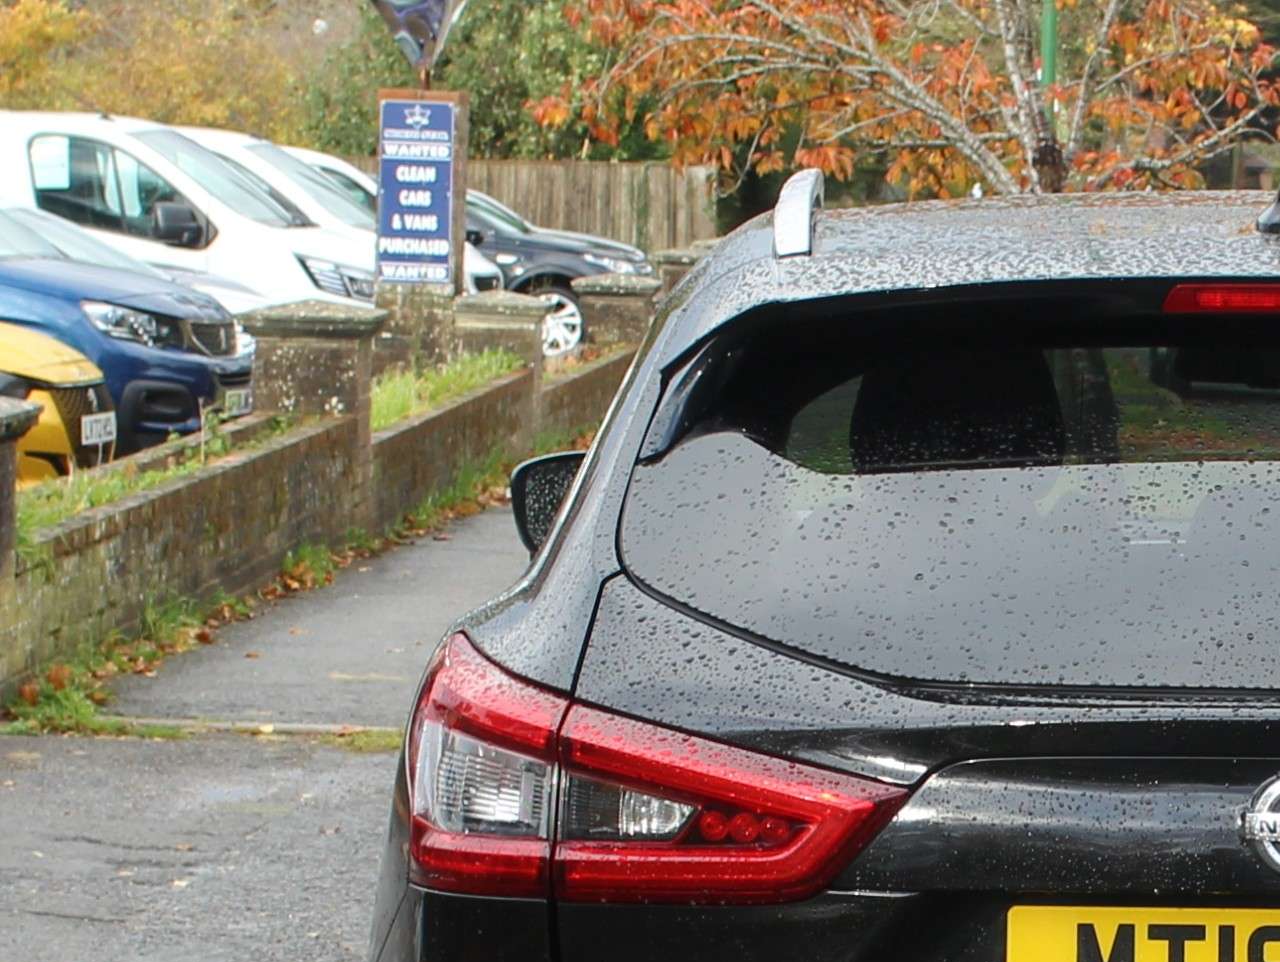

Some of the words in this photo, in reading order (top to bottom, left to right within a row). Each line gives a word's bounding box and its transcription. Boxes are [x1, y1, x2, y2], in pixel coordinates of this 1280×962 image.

[383, 143, 450, 157] WANTED
[395, 165, 437, 183] CLEAN
[398, 189, 432, 207] CARS
[391, 214, 402, 230] &
[403, 214, 438, 231] VANS
[378, 236, 450, 256] PURCHASED
[380, 265, 448, 280] WANTED
